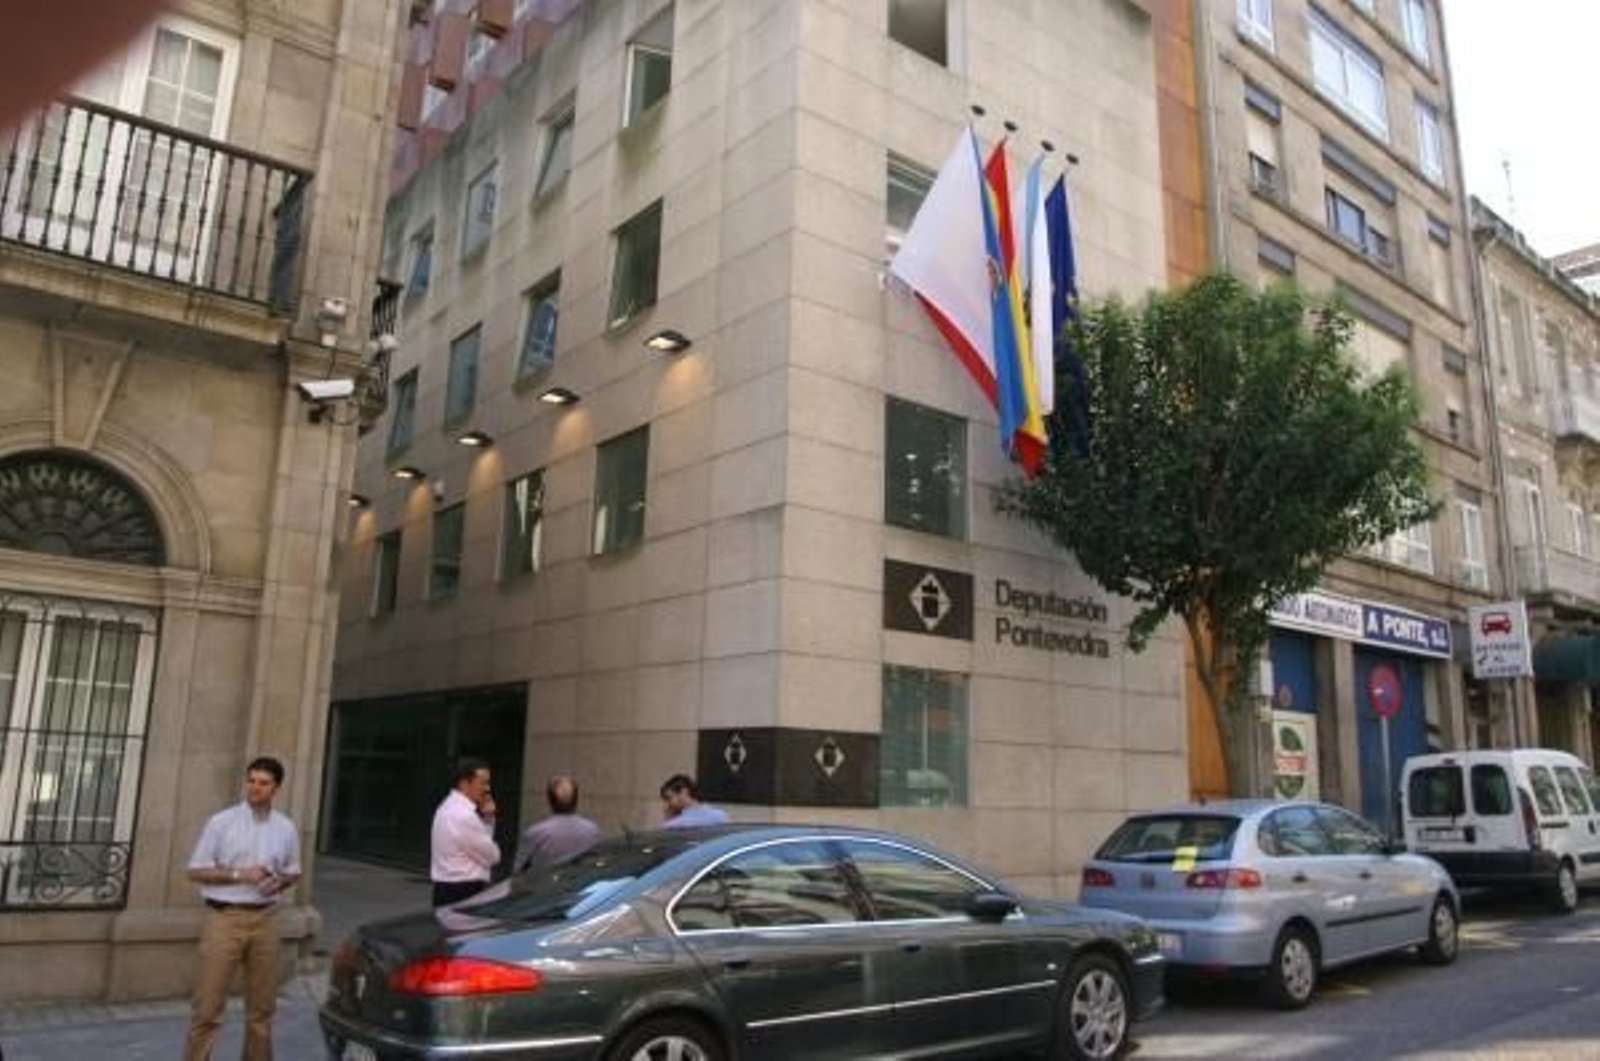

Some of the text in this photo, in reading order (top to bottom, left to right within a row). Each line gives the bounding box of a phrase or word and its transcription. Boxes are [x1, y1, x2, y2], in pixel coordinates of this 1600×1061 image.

[996, 579, 1107, 622] Deputación
[996, 617, 1109, 658] Pontevedra
[1367, 609, 1379, 634] A
[1382, 613, 1429, 648] PONTE,
